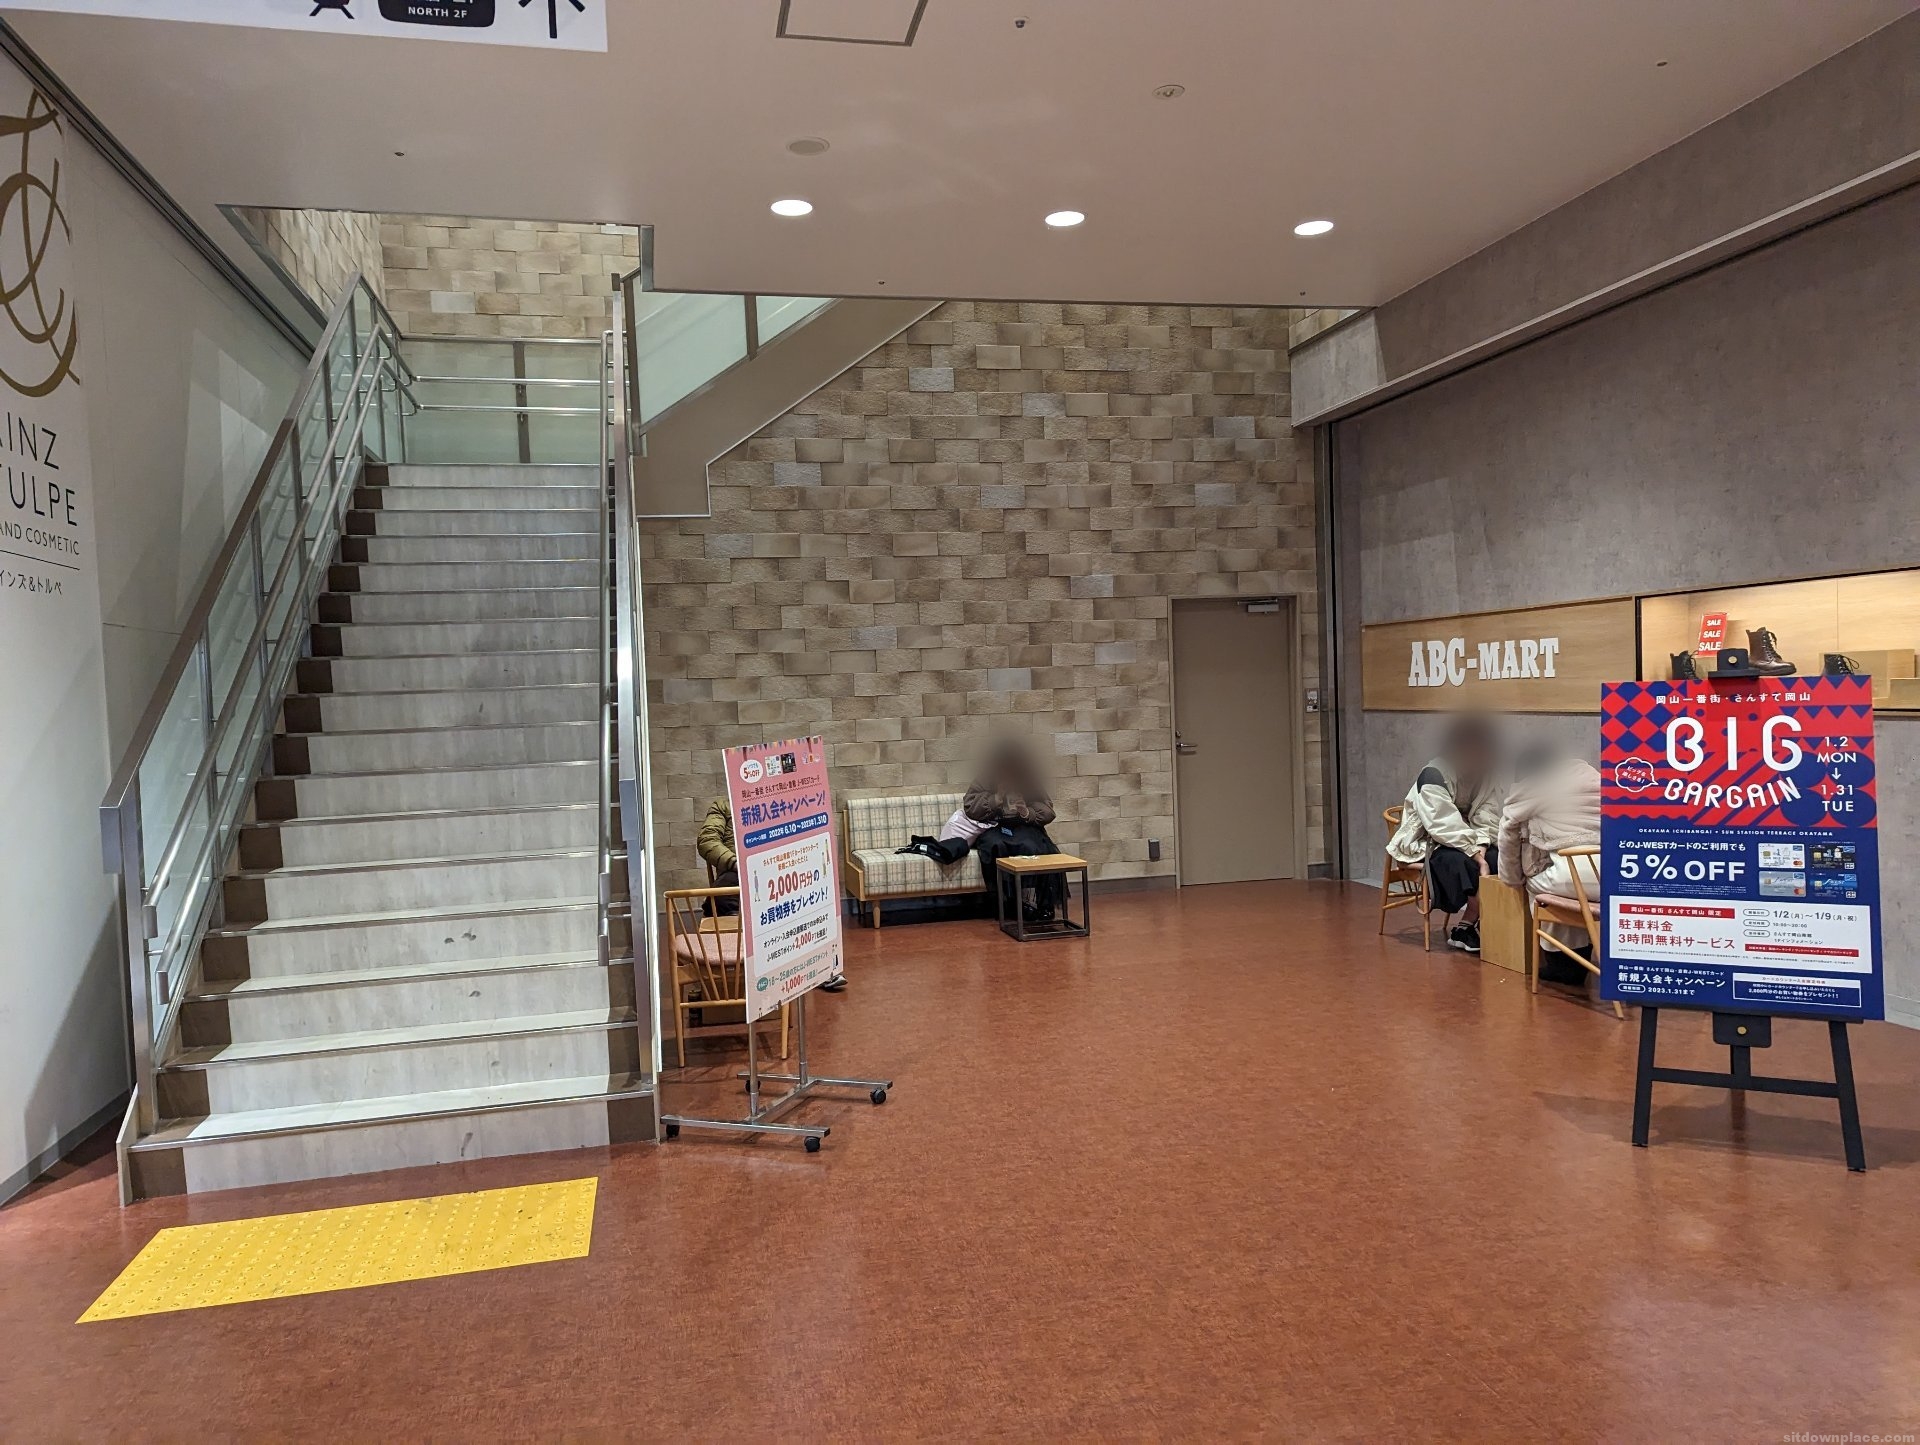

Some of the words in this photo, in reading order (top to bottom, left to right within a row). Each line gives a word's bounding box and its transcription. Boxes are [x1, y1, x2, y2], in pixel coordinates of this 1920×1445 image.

[407, 6, 449, 17] NORTH
[453, 9, 468, 18] 2F
[0, 411, 60, 470] INZ
[0, 463, 78, 526] ULPE
[25, 526, 80, 556] COSMETIC
[1706, 619, 1722, 627] SALE
[1702, 630, 1722, 639] SALE
[1698, 641, 1722, 651] SALE
[1408, 637, 1560, 688] ABC-MART
[1655, 691, 1812, 705] 岡山一番街・さんすて岡山
[1665, 714, 1804, 773] BIG
[1824, 736, 1849, 748] 1.2
[1816, 752, 1857, 764] MON
[1663, 776, 1803, 809] BARGAIN
[1820, 784, 1855, 796] 1.31
[1821, 800, 1855, 812] TUE
[1618, 840, 1747, 852] どのJ-WESTカードのご利用でも
[1683, 859, 1747, 882] OFF
[1618, 918, 1674, 932] 駐車料金
[1617, 933, 1736, 949] 3時間無料サービス
[1617, 972, 1726, 988] 新規入会キャンペーン
[1647, 986, 1697, 996] 2023.1.31まで
